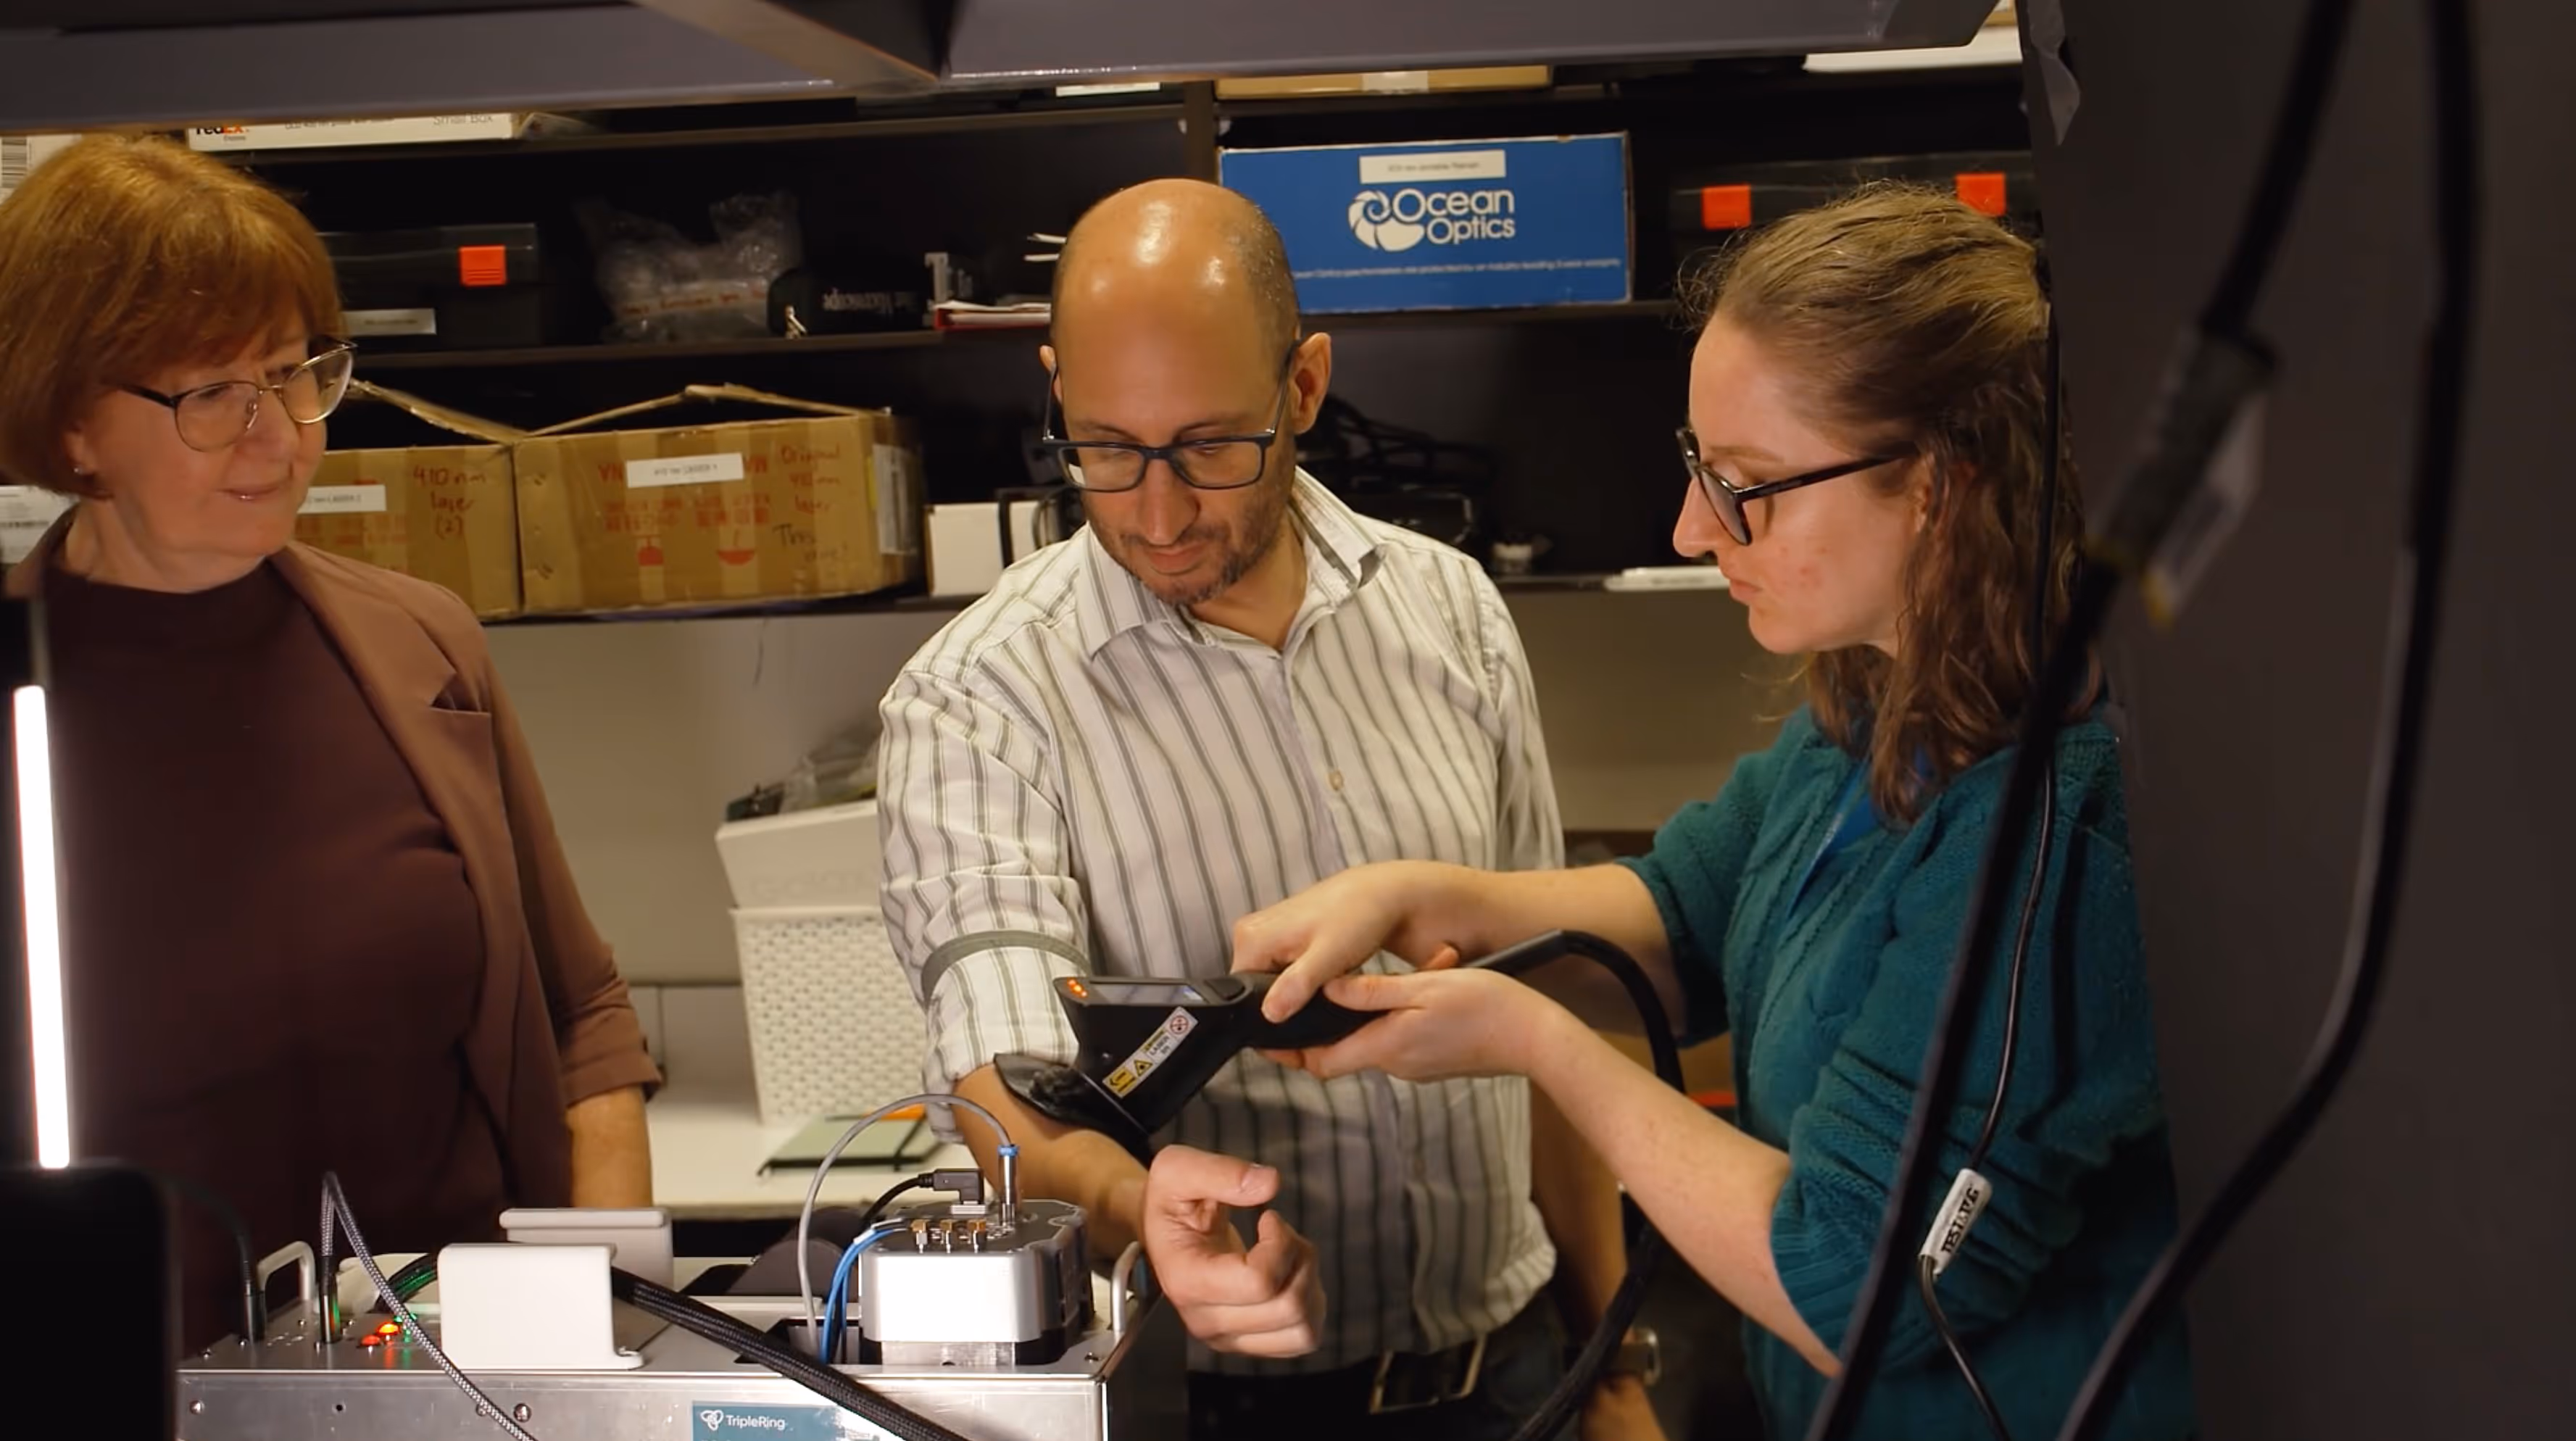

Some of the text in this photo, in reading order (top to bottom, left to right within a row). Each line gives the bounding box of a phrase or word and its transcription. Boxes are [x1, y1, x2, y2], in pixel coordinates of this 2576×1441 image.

[1392, 188, 1515, 223] Ocean
[1426, 217, 1515, 245] Optics
[726, 1414, 786, 1432] TripleRing
